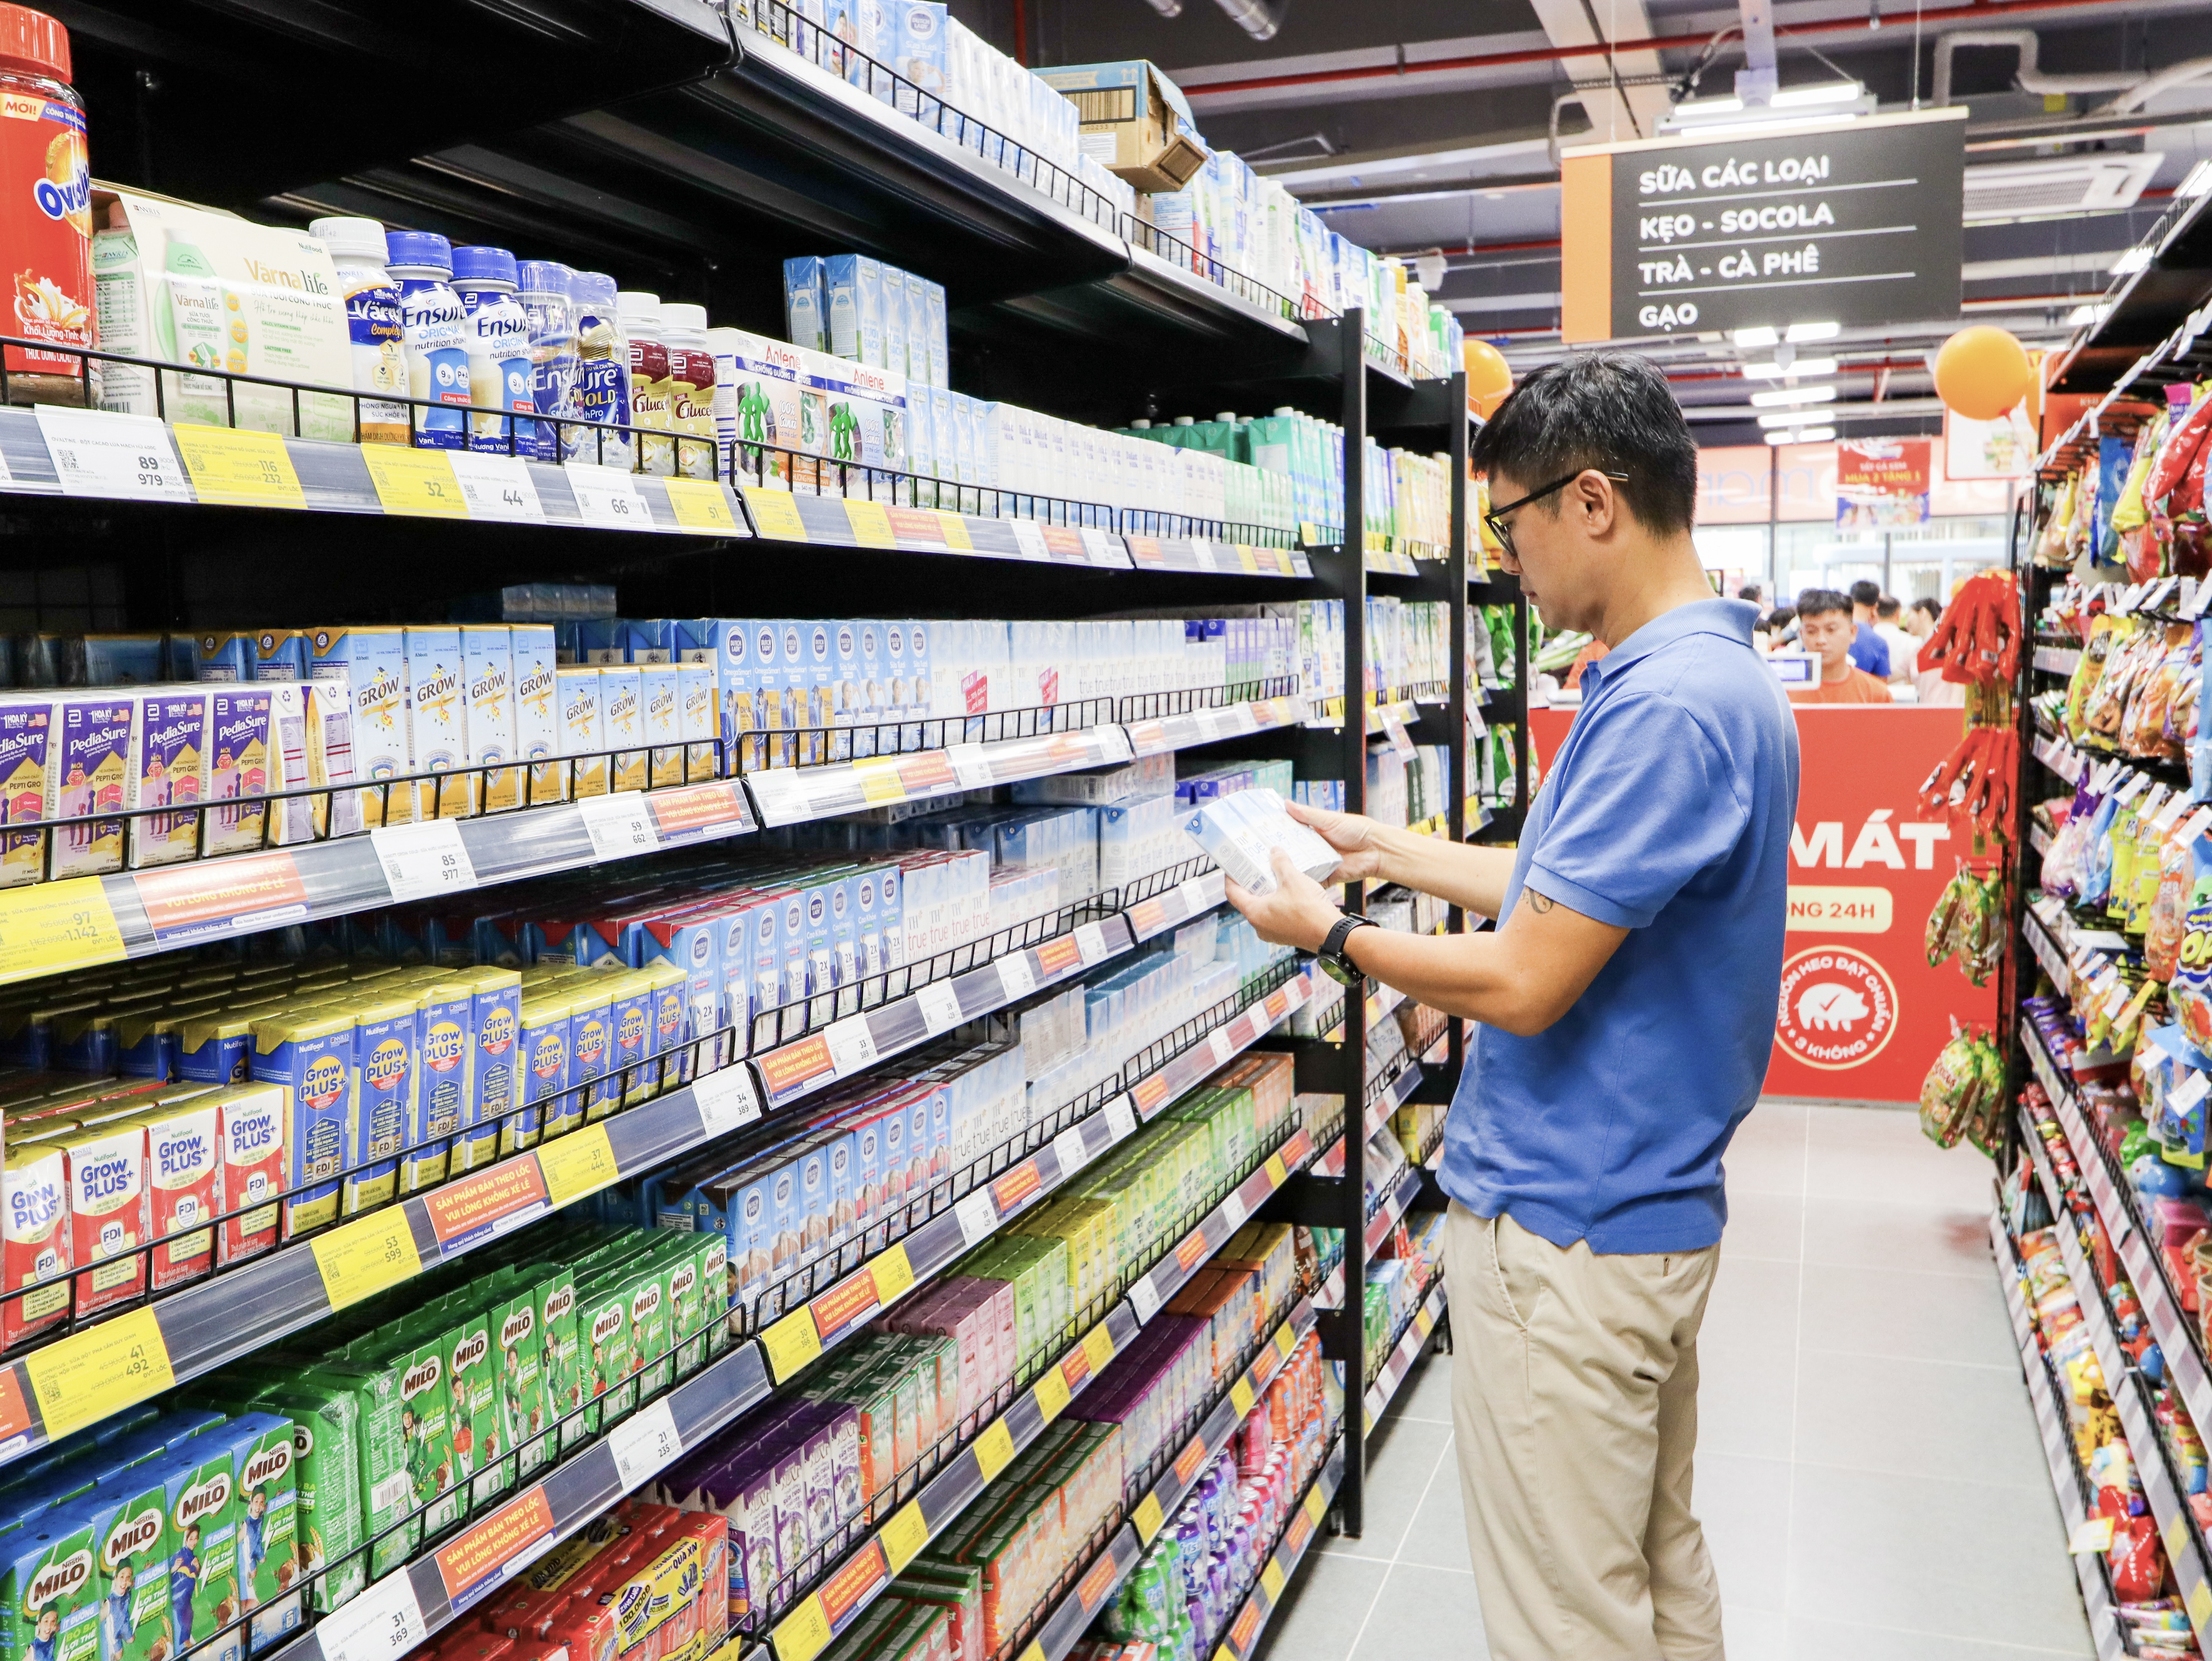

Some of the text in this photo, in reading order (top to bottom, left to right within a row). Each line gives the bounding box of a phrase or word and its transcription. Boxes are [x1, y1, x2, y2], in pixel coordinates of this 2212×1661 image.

[5, 100, 37, 115] MỚI!
[1639, 155, 1829, 194] SỮA CÁC LOẠI
[1640, 213, 1695, 243] KẸO
[1721, 202, 1834, 233] SOCOLA
[298, 243, 323, 253] Nutifood
[1639, 254, 1693, 284] TRÀ
[1719, 249, 1758, 278] CÀ
[1764, 243, 1819, 275] PHÊ
[243, 257, 328, 295] Värna life
[176, 294, 219, 310] Värna life
[403, 305, 465, 327] Ensure
[1639, 302, 1698, 331] GẠO
[24, 325, 41, 336] Khối
[42, 327, 64, 340] Lượng
[415, 339, 450, 350] nutrition
[766, 345, 800, 370] Anlene
[854, 368, 884, 390] Anlene
[139, 456, 158, 470] 89
[260, 461, 277, 473] 116
[138, 474, 163, 485] 979
[262, 474, 281, 484] 232
[424, 482, 445, 497] 32
[501, 490, 523, 506] 44
[612, 499, 629, 514] 66
[723, 668, 752, 677] OmegaSmart
[417, 674, 456, 702] GROW
[520, 669, 553, 696] GROW
[359, 677, 399, 707] GROW
[567, 696, 594, 720] GROW
[149, 721, 200, 748] PediaSure
[219, 715, 267, 741] PediaSure
[70, 728, 126, 755] PediaSure
[632, 822, 642, 831] 59
[633, 835, 646, 844] 662
[1789, 809, 1950, 870] MÁT
[442, 854, 456, 866] 85
[443, 870, 458, 880] 977
[73, 911, 92, 926] 97
[1786, 902, 1875, 919] NG 24H
[66, 926, 98, 941] 1.142
[908, 930, 927, 948] true
[1798, 956, 1833, 976] HEO
[484, 1013, 512, 1030] Grow
[480, 1025, 516, 1046] PLUS+
[299, 1041, 324, 1053] Nutifood
[370, 1046, 404, 1064] Grow
[536, 1042, 560, 1055] Grow
[1807, 1039, 1867, 1060] KHÔNG
[305, 1063, 341, 1083] Grow
[366, 1059, 409, 1083] PLUS+
[299, 1077, 347, 1102] PLUS+
[737, 1094, 746, 1104] 34
[738, 1105, 749, 1115] 389
[231, 1114, 271, 1137] Grow
[234, 1125, 276, 1153] PLUS+
[94, 1151, 117, 1163] Nutifood
[592, 1149, 601, 1159] 37
[81, 1159, 127, 1184] Grow
[316, 1163, 330, 1173] FDI
[591, 1161, 604, 1170] 444
[84, 1169, 134, 1201] PLUS+
[249, 1177, 265, 1190] FDI
[436, 1163, 531, 1210] SẢN PHẨM BÁN THEO LỐC
[445, 1177, 531, 1222] VUI LÒNG KHÔNG XÉ LẺ
[103, 1227, 122, 1241] FDI
[385, 1236, 398, 1248] 53
[385, 1249, 401, 1263] 599
[672, 1276, 693, 1292] MILO
[547, 1297, 570, 1317] MILO
[504, 1316, 530, 1340] MILO
[596, 1318, 620, 1337] MILO
[130, 1345, 144, 1358] 41
[456, 1341, 484, 1366] MILO
[126, 1359, 149, 1376] 492
[404, 1369, 436, 1394] MILO
[658, 1432, 667, 1443] 21
[658, 1445, 670, 1458] 235
[248, 1452, 287, 1483] MILO
[182, 1485, 225, 1519] MILO
[111, 1521, 155, 1558] MILO
[702, 1539, 725, 1581] Ovaltine
[34, 1563, 83, 1602] MILO
[392, 1612, 405, 1627] 31
[390, 1627, 407, 1646] 369
